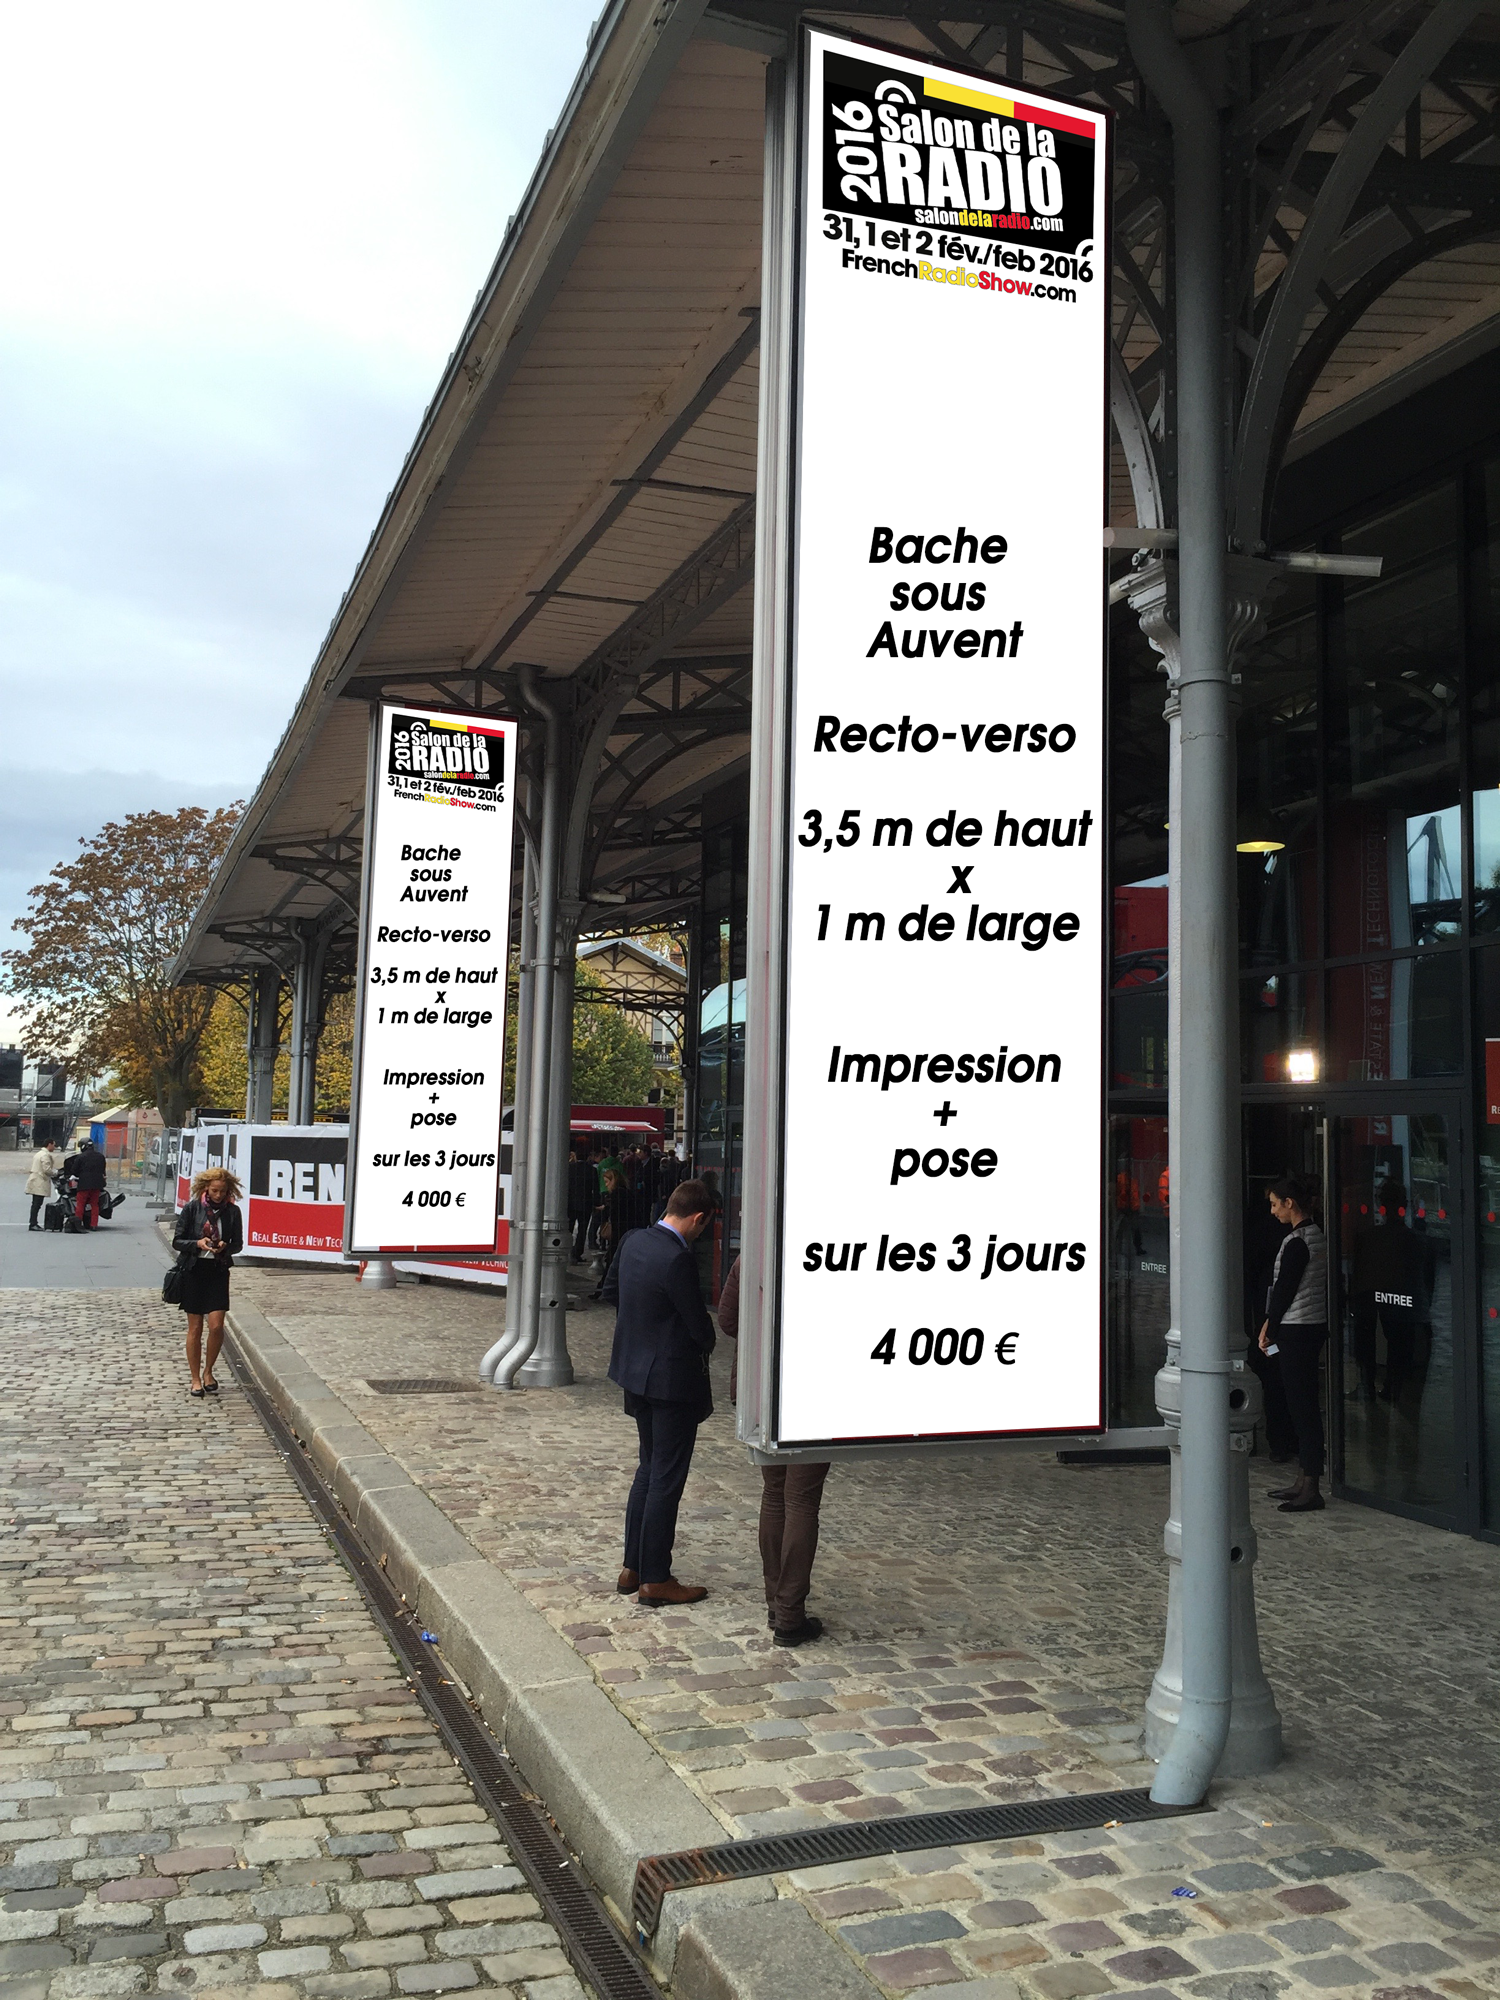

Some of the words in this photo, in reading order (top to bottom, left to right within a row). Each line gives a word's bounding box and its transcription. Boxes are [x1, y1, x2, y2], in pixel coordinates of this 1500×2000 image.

[877, 103, 976, 149] Salon
[981, 117, 1021, 155] de
[1026, 121, 1057, 158] la
[831, 100, 882, 203] 2016
[881, 140, 1064, 217] RADIO
[914, 206, 1064, 232] salondelaradio.com
[822, 213, 861, 249] 31,
[865, 220, 876, 247] 1
[881, 227, 912, 252] et
[915, 230, 934, 256] 2
[937, 234, 1036, 273] fév./feb
[1039, 252, 1094, 283] 2016
[842, 247, 1077, 304] FrenchRadioShow.com
[869, 527, 1007, 564] Bache
[890, 582, 986, 611] sous
[866, 622, 1023, 658] Auvent
[410, 730, 451, 747] Salon
[452, 732, 471, 748] de
[472, 733, 487, 748] la
[814, 716, 1076, 752] Recto-verso
[393, 730, 412, 771] 2016
[411, 745, 490, 773] RADIO
[423, 770, 490, 780] salondelaradio.com
[387, 775, 403, 790] 31,
[403, 777, 409, 789] 1
[410, 779, 422, 790] et
[423, 781, 432, 792] 2
[432, 782, 477, 799] fév./feb
[478, 789, 505, 803] 2016
[393, 788, 497, 812] FrenchRadioShow.com
[799, 810, 860, 853] 3,5
[873, 818, 912, 846] m
[926, 810, 982, 847] de
[994, 810, 1093, 847] haut
[401, 844, 462, 862] Bache
[409, 868, 453, 882] sous
[947, 866, 974, 893] x
[400, 885, 469, 902] Auvent
[377, 925, 491, 943] Recto-verso
[818, 905, 830, 940] 1
[845, 913, 885, 940] m
[899, 905, 954, 941] de
[967, 905, 1079, 951] large
[371, 966, 399, 987] 3,5
[403, 971, 421, 984] m
[426, 966, 451, 984] de
[455, 966, 499, 984] haut
[435, 991, 447, 1004] x
[379, 1008, 385, 1024] 1
[391, 1011, 409, 1024] m
[414, 1008, 439, 1025] de
[443, 1007, 493, 1028] large
[384, 1068, 485, 1088] Impression
[828, 1046, 1061, 1090] Impression
[429, 1092, 440, 1105] +
[411, 1112, 457, 1130] pose
[934, 1101, 957, 1126] +
[372, 1154, 401, 1167] sur
[403, 1150, 431, 1167] les
[434, 1150, 446, 1167] 3
[448, 1150, 496, 1171] jours
[891, 1148, 997, 1185] pose
[268, 1159, 345, 1202] REN
[402, 1190, 414, 1207] 4
[418, 1190, 452, 1207] 000
[455, 1192, 467, 1208] €
[252, 1231, 271, 1243] REAL
[272, 1233, 298, 1246] ESTATE
[299, 1236, 304, 1246] &
[305, 1235, 324, 1247] NEW
[803, 1243, 867, 1271] sur
[877, 1235, 936, 1271] les
[947, 1234, 970, 1271] 3
[981, 1235, 1086, 1279] jours
[1141, 1261, 1167, 1274] ENTREE
[1374, 1291, 1413, 1308] ENTREE
[871, 1329, 896, 1364] 4
[909, 1328, 984, 1365] 000
[995, 1332, 1019, 1365] €
